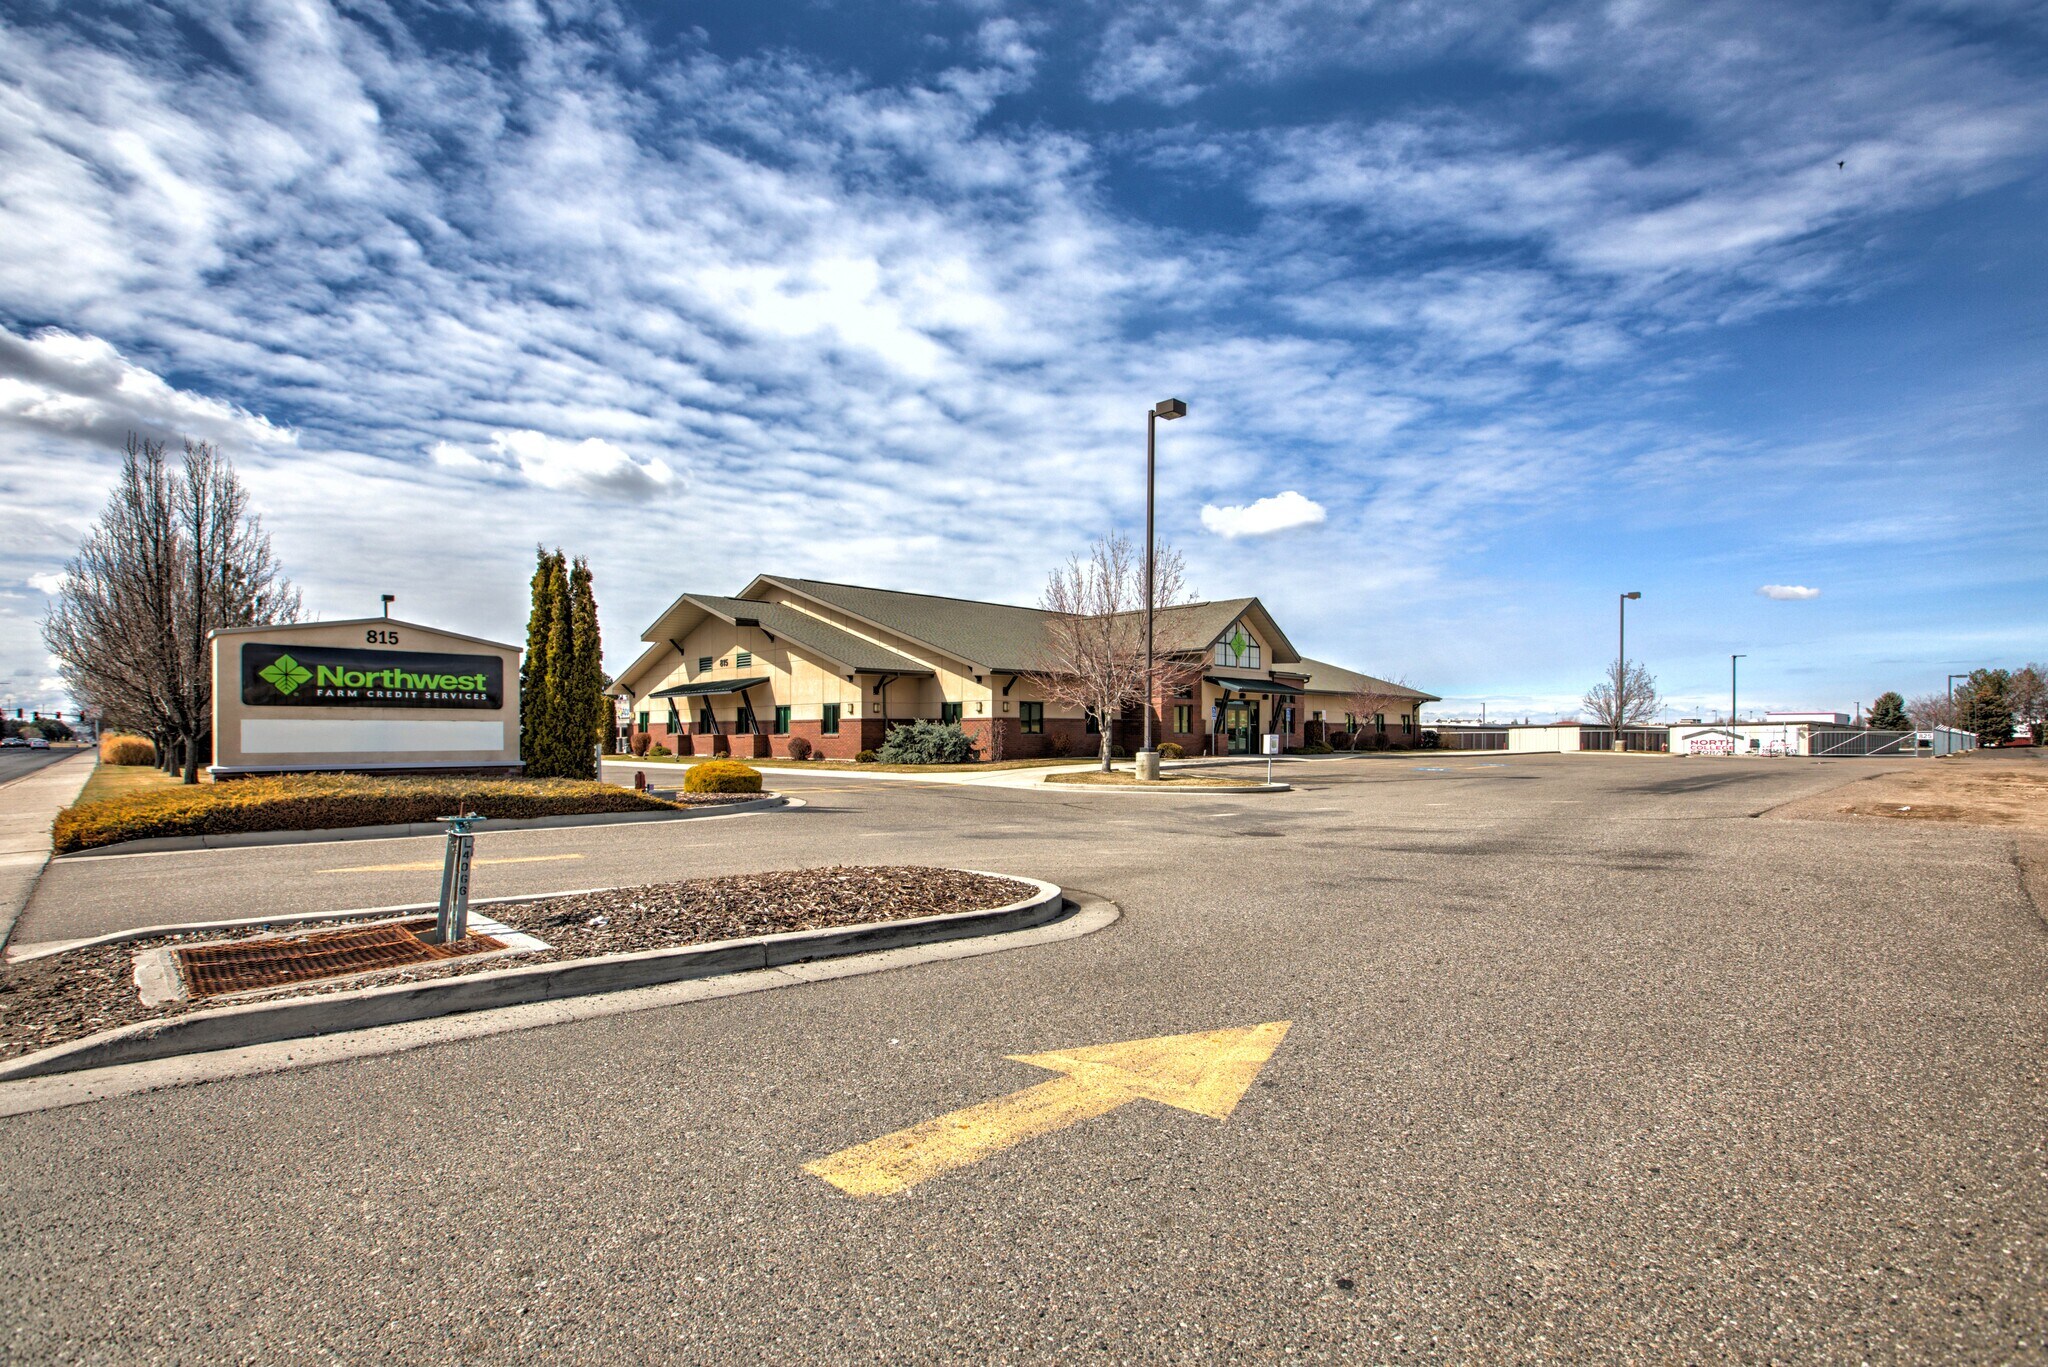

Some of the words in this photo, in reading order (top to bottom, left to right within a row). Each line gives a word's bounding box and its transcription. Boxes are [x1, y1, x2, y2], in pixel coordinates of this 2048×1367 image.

[366, 630, 399, 645] 815
[720, 659, 728, 667] 815
[317, 665, 487, 690] Northwest
[317, 689, 358, 697] FARM
[366, 690, 418, 699] CREDIT
[425, 692, 487, 700] SERVICES
